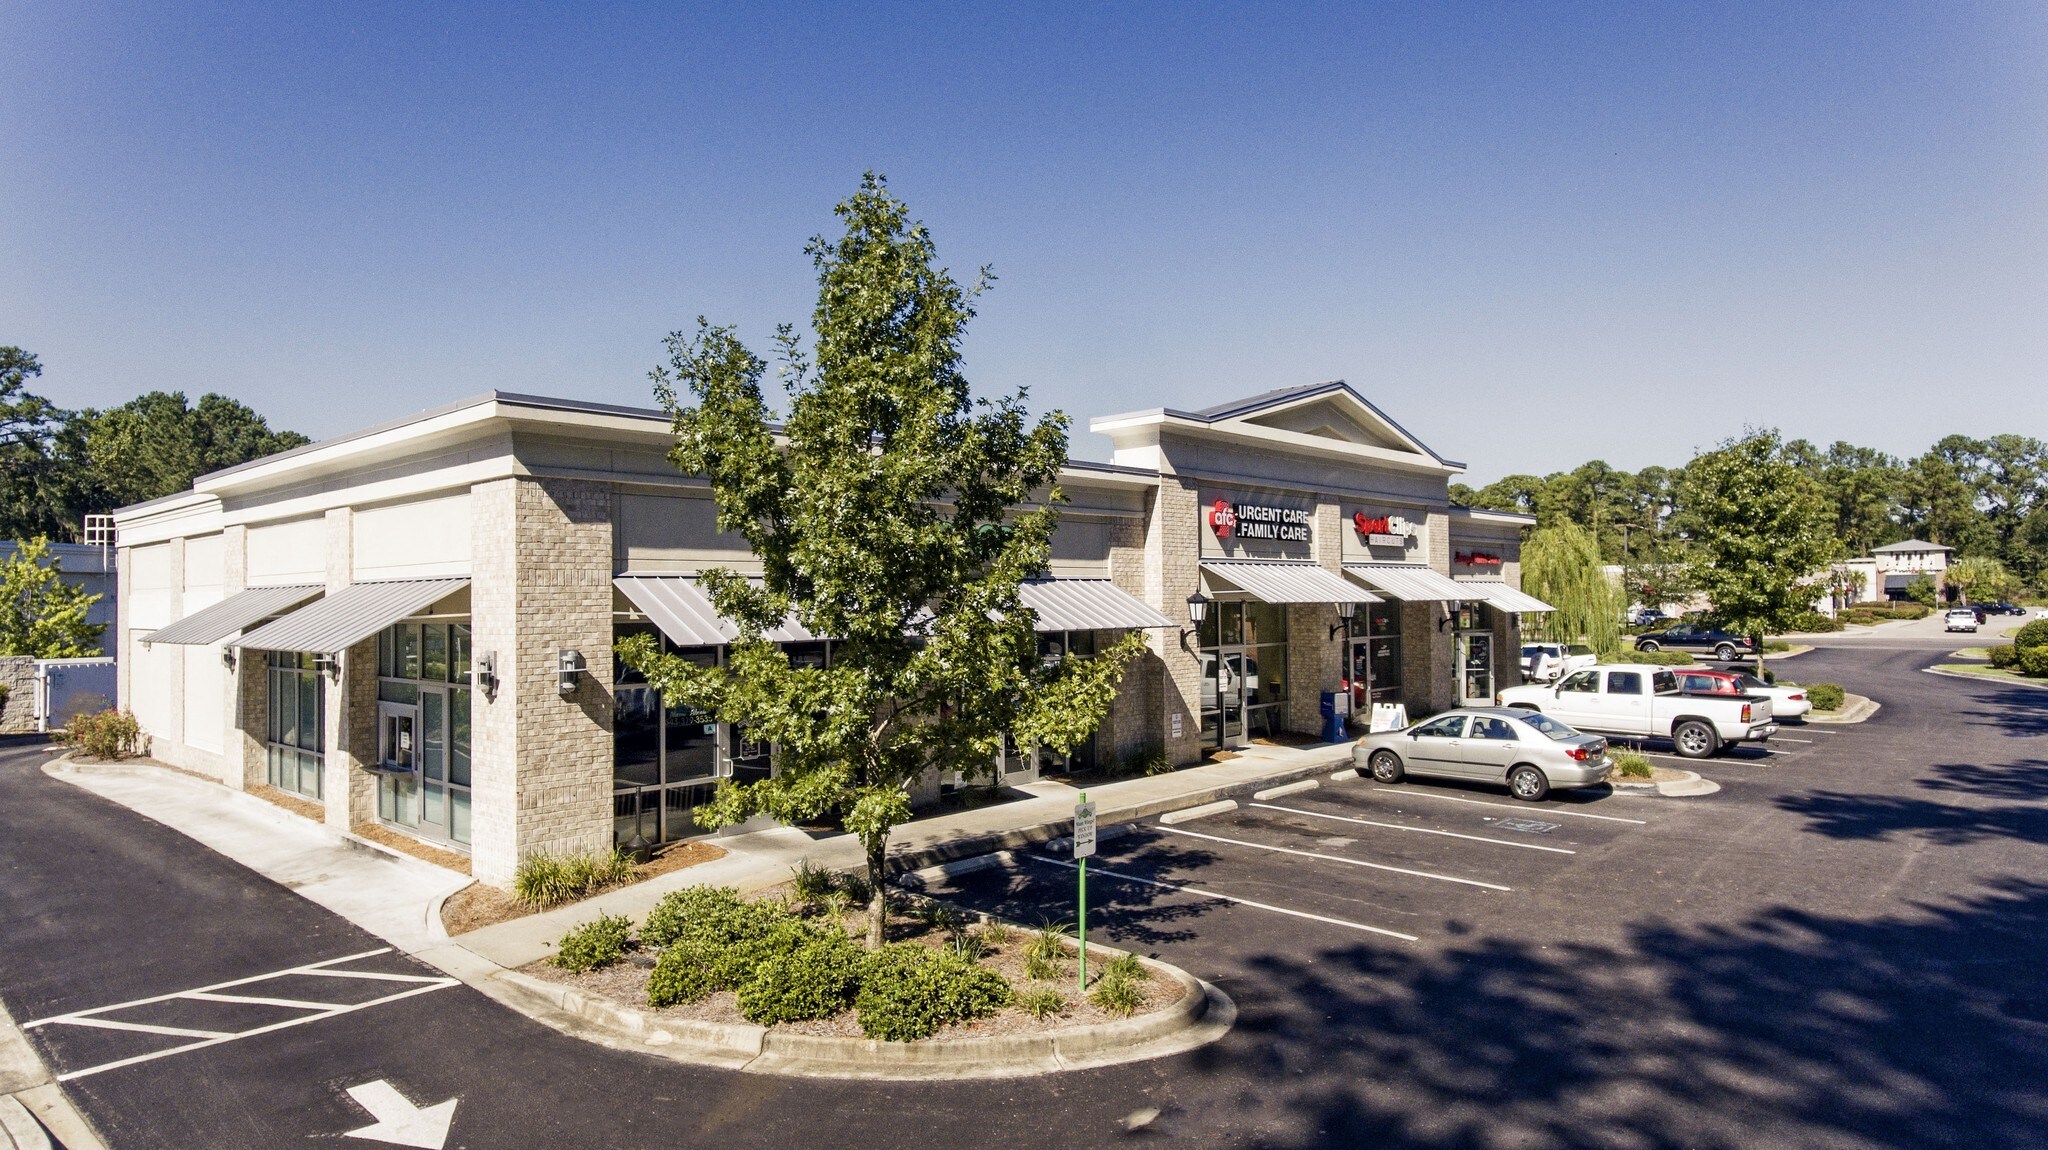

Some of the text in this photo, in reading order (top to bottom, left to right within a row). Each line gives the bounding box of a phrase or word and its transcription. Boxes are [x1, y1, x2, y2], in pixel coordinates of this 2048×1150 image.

[1214, 508, 1234, 525] afc
[1239, 505, 1309, 524] URGENT CARE
[1241, 523, 1308, 540] FAMILY CARE
[1370, 536, 1403, 545] HAIRCUTS
